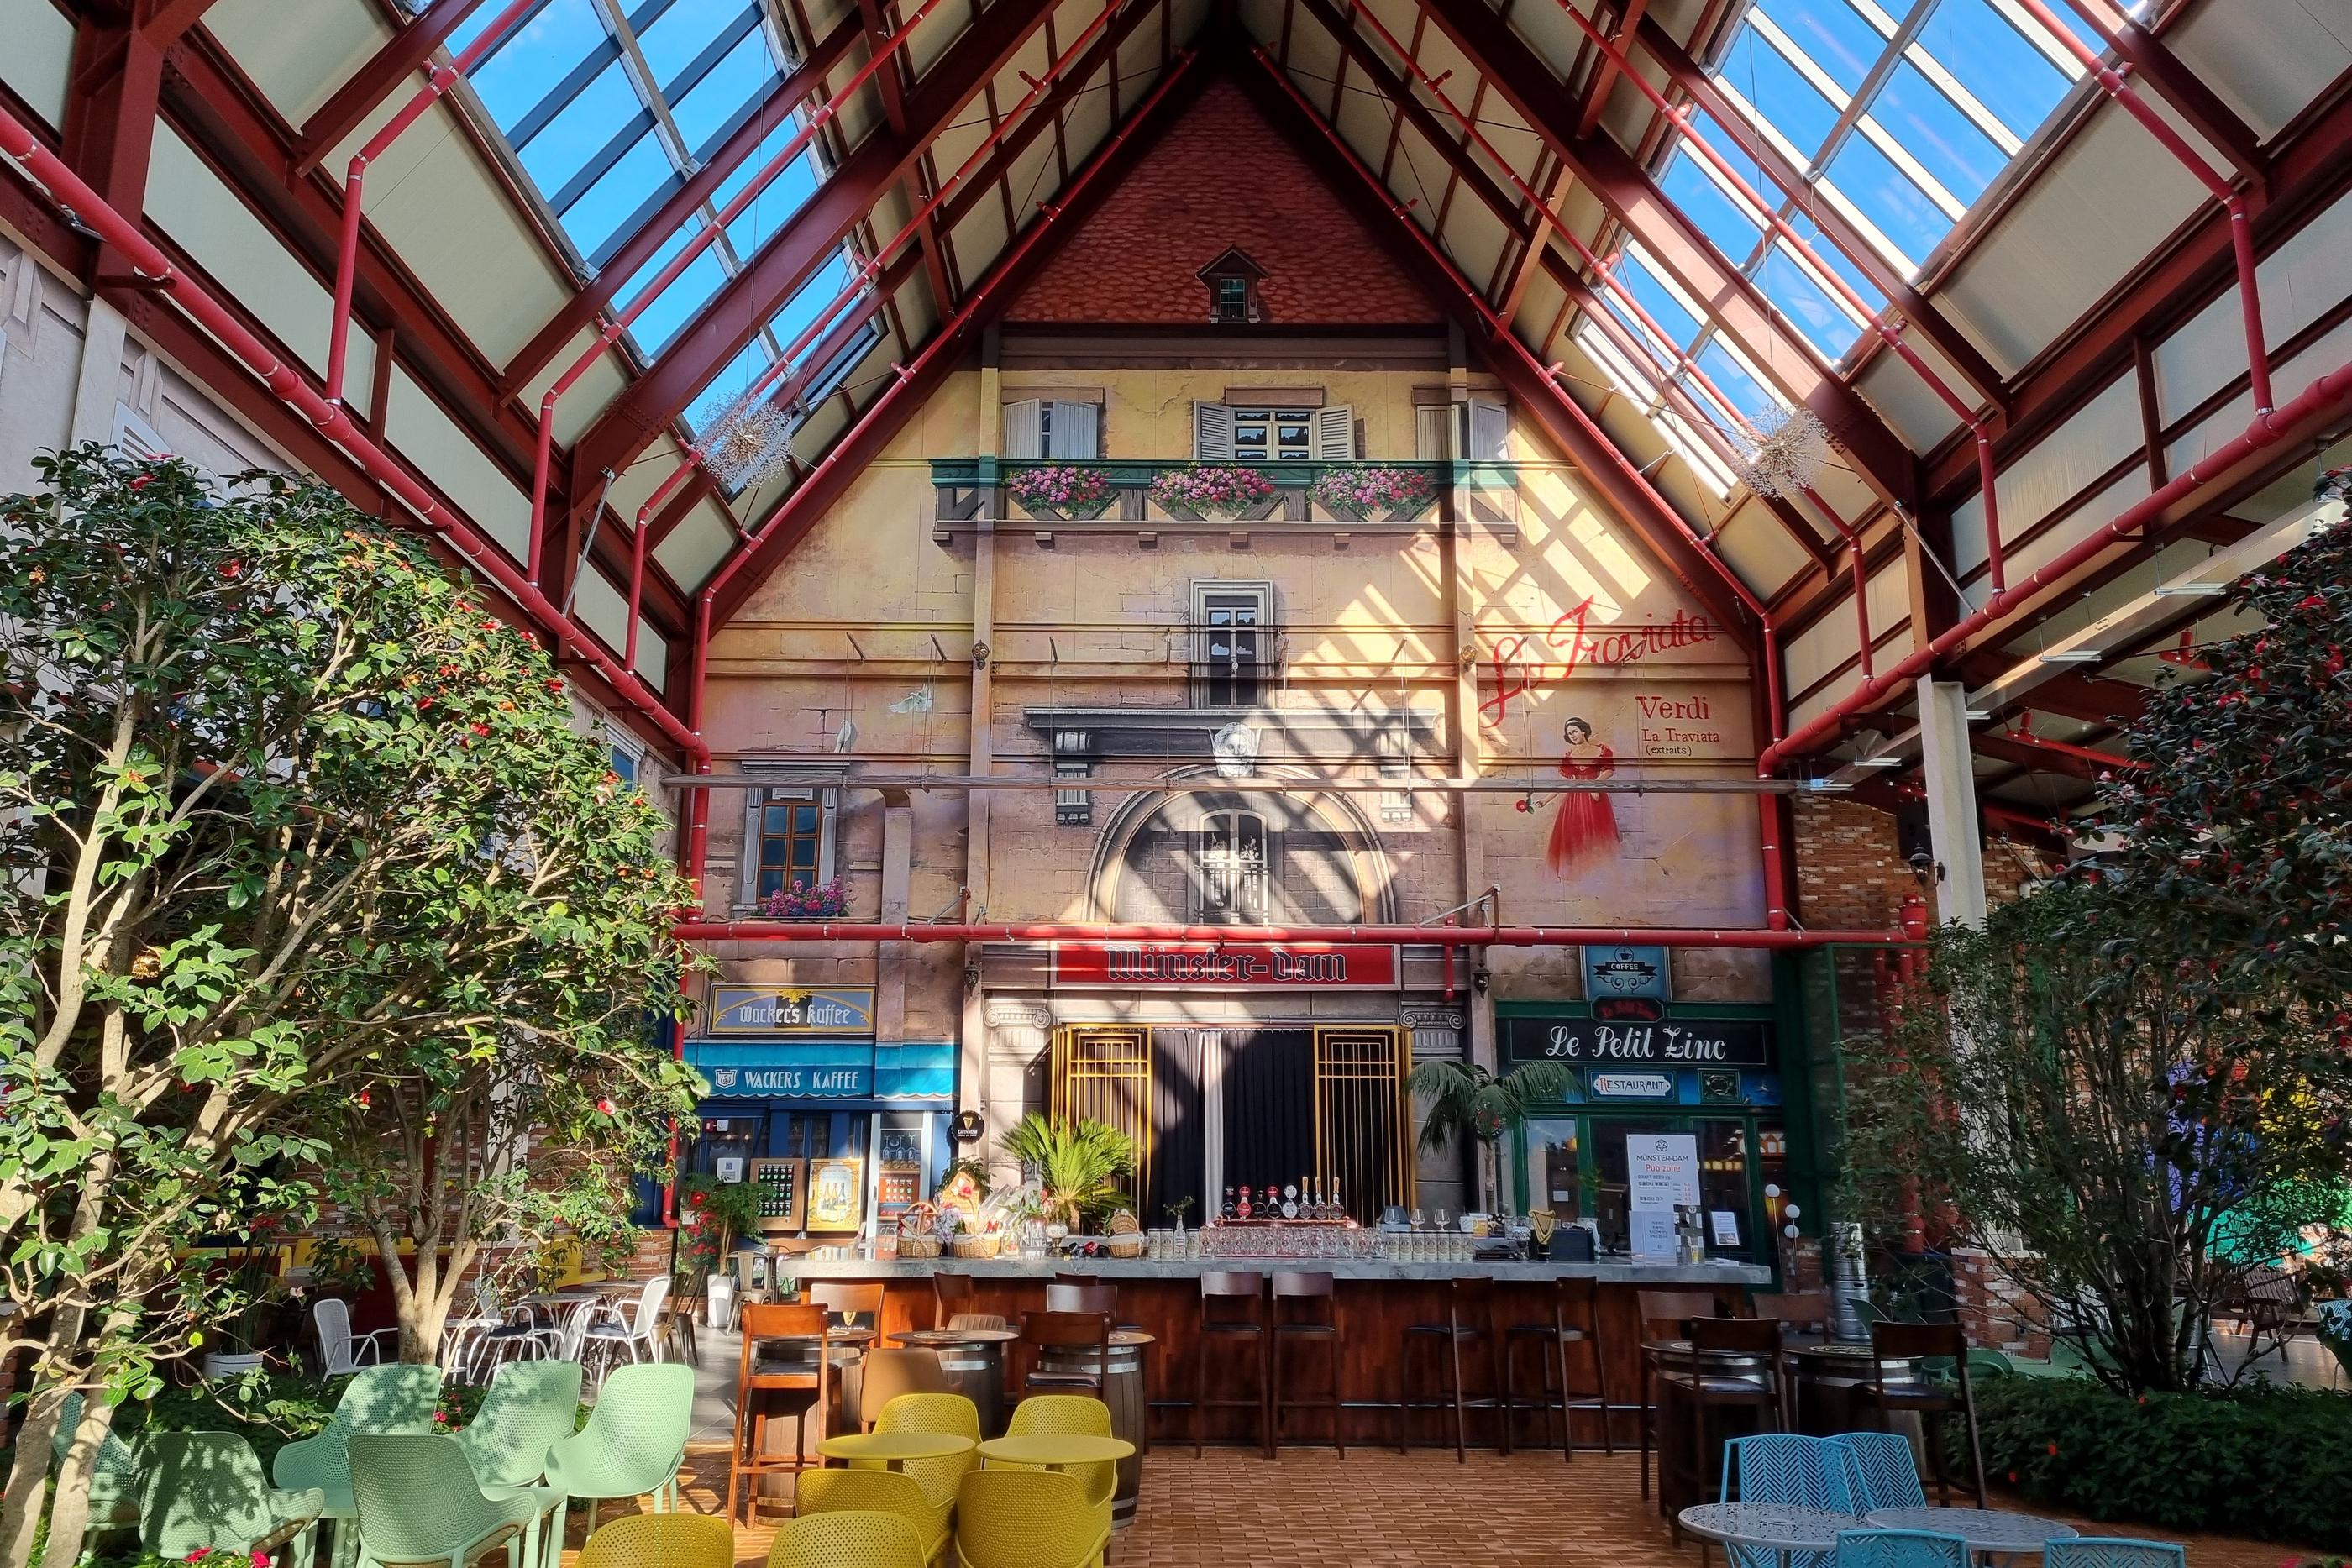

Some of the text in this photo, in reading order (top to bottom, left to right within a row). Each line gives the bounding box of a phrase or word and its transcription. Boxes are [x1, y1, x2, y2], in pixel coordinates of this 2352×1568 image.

[1635, 695, 1710, 720] Verdi
[1641, 727, 1720, 742] La Traviata
[1646, 744, 1693, 757] (extraits)
[1546, 1025, 1725, 1060] Le Petit Zinc
[744, 1071, 859, 1090] WACKERS KAFFEE
[1599, 1077, 1664, 1093] RESTAURANT
[1646, 1164, 1660, 1172] Pub
